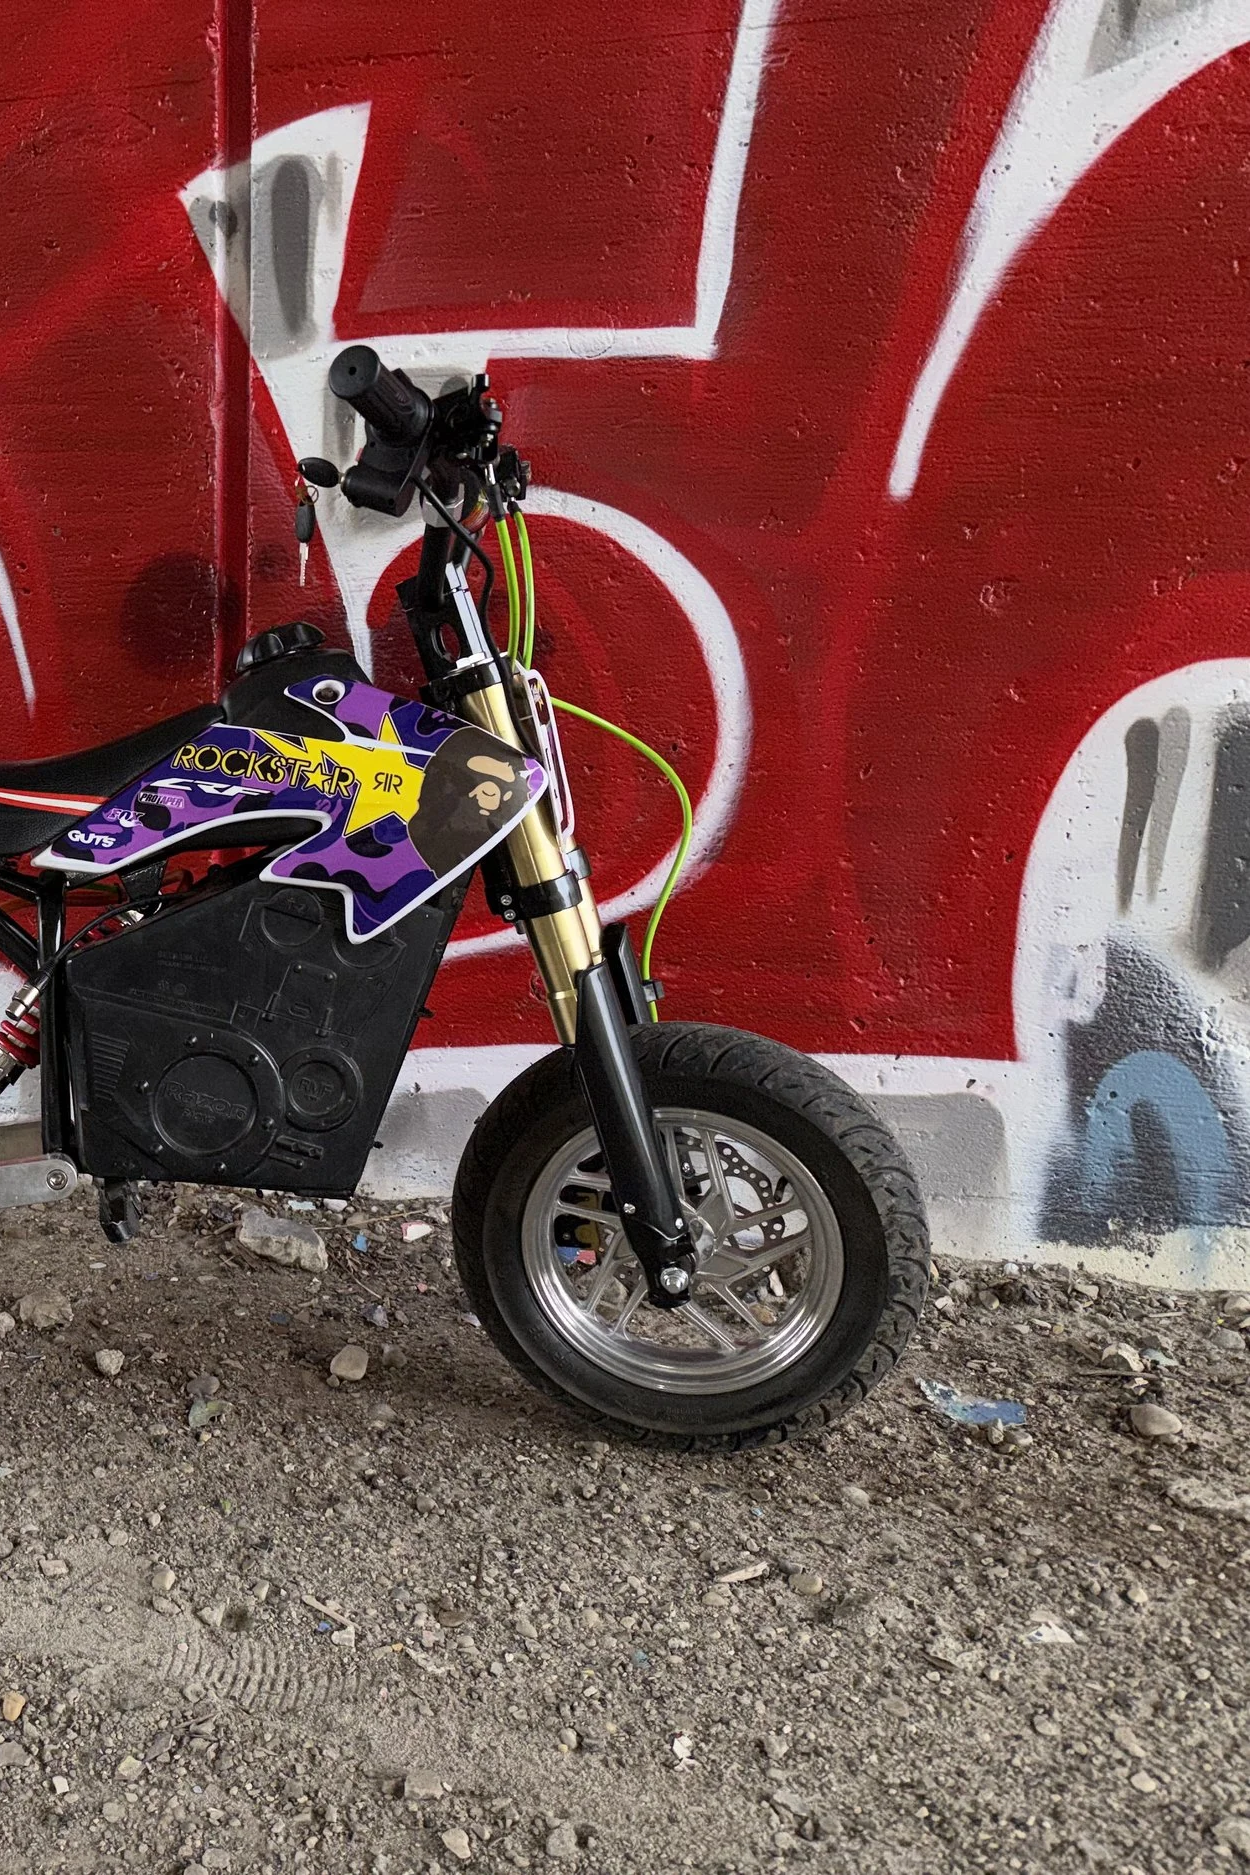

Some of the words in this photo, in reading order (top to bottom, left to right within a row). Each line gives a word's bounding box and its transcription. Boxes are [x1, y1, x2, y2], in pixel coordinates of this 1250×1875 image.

[138, 792, 184, 808] PROTAPER
[105, 807, 146, 828] FOX
[66, 829, 117, 849] GUTS
